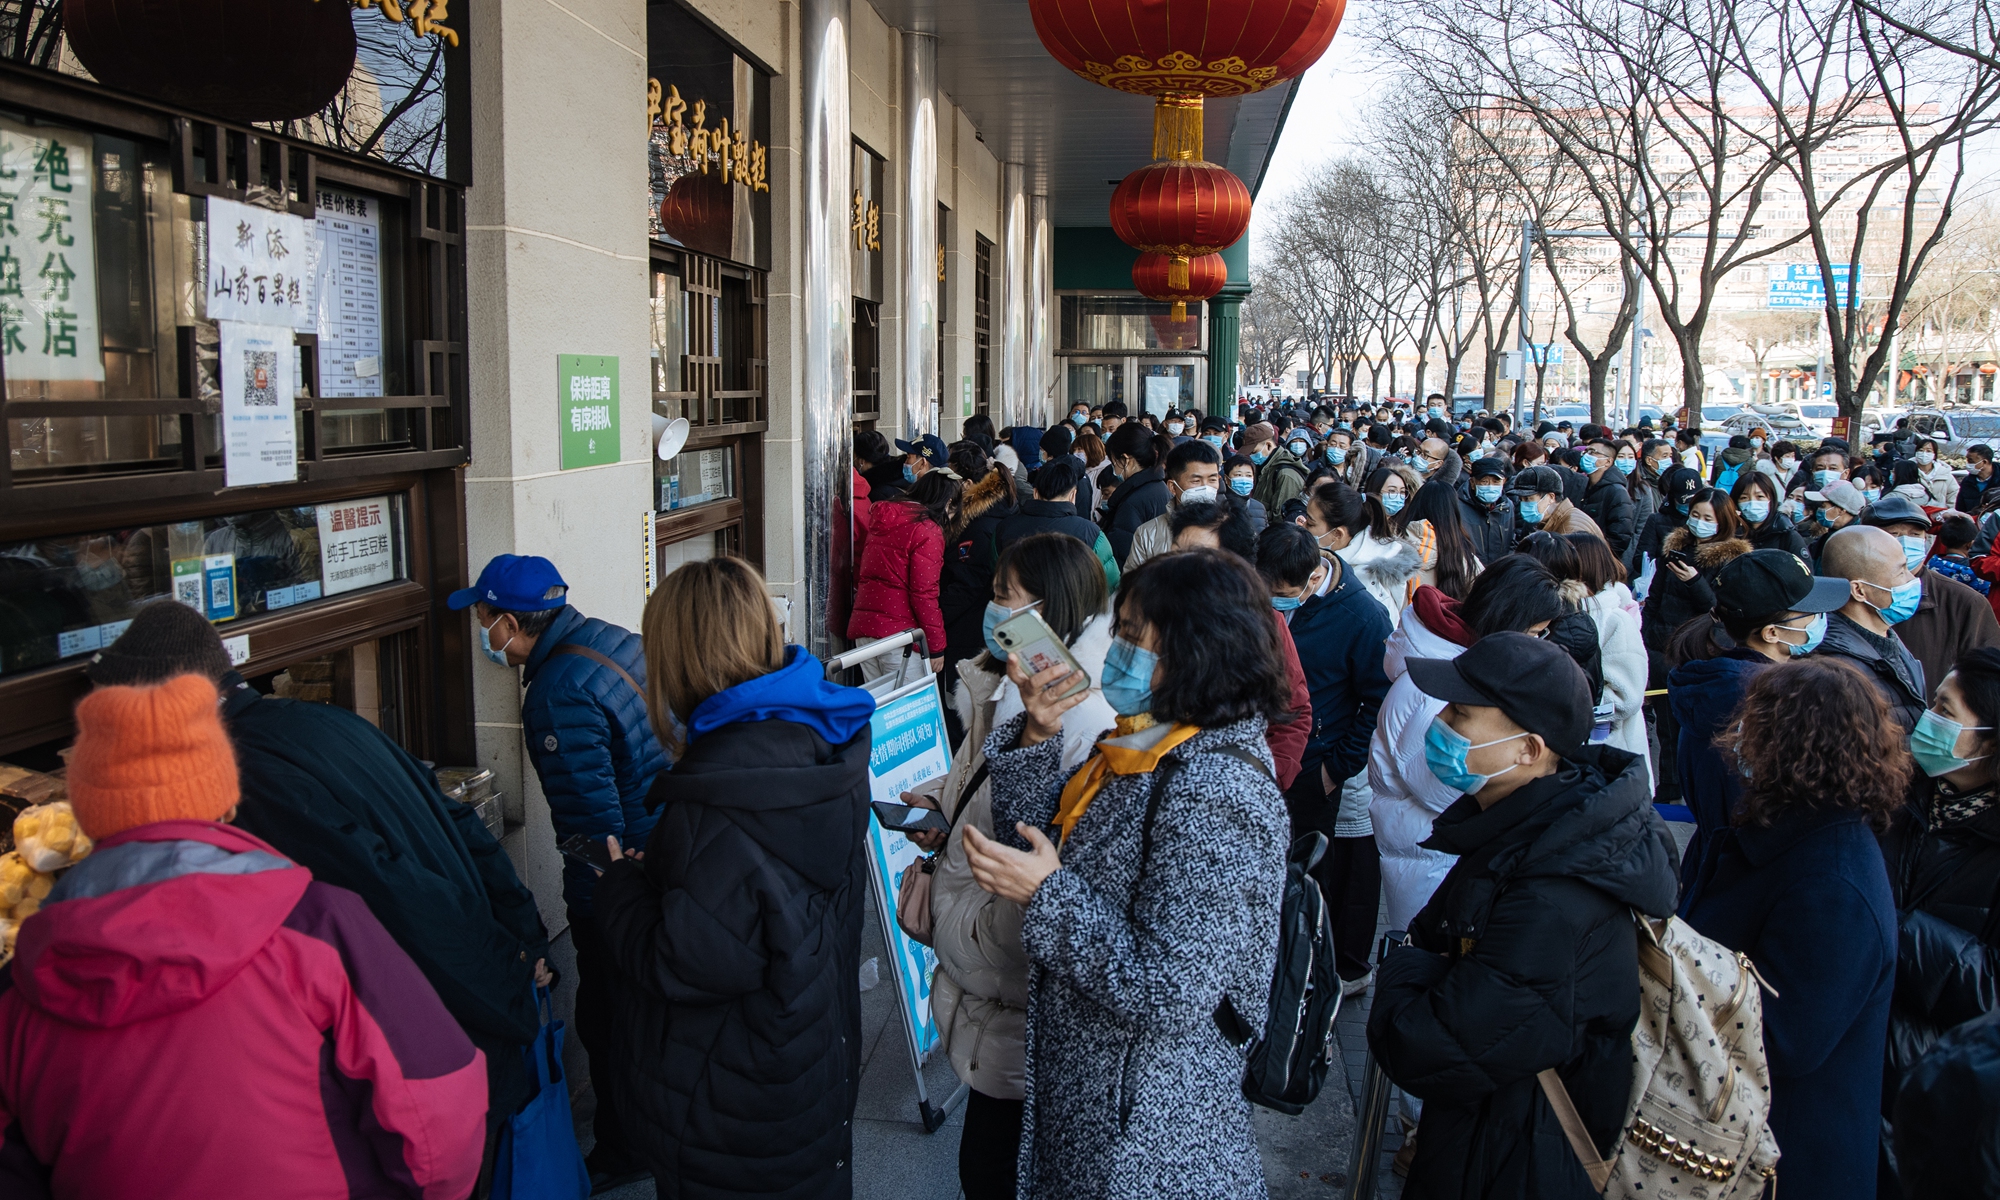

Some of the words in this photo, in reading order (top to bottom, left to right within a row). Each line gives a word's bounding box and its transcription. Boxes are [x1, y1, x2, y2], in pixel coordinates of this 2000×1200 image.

[235, 219, 289, 260] 新添
[852, 188, 881, 252] 年糕
[34, 139, 77, 358] 绝无分店
[214, 265, 302, 308] 山药百果糕
[570, 375, 611, 401] 保持距离
[570, 405, 612, 432] 有序排队
[330, 504, 381, 532] 温馨提示
[326, 533, 389, 563] 纯手工芸豆糕
[870, 722, 933, 768] 疫情期间排队须知
